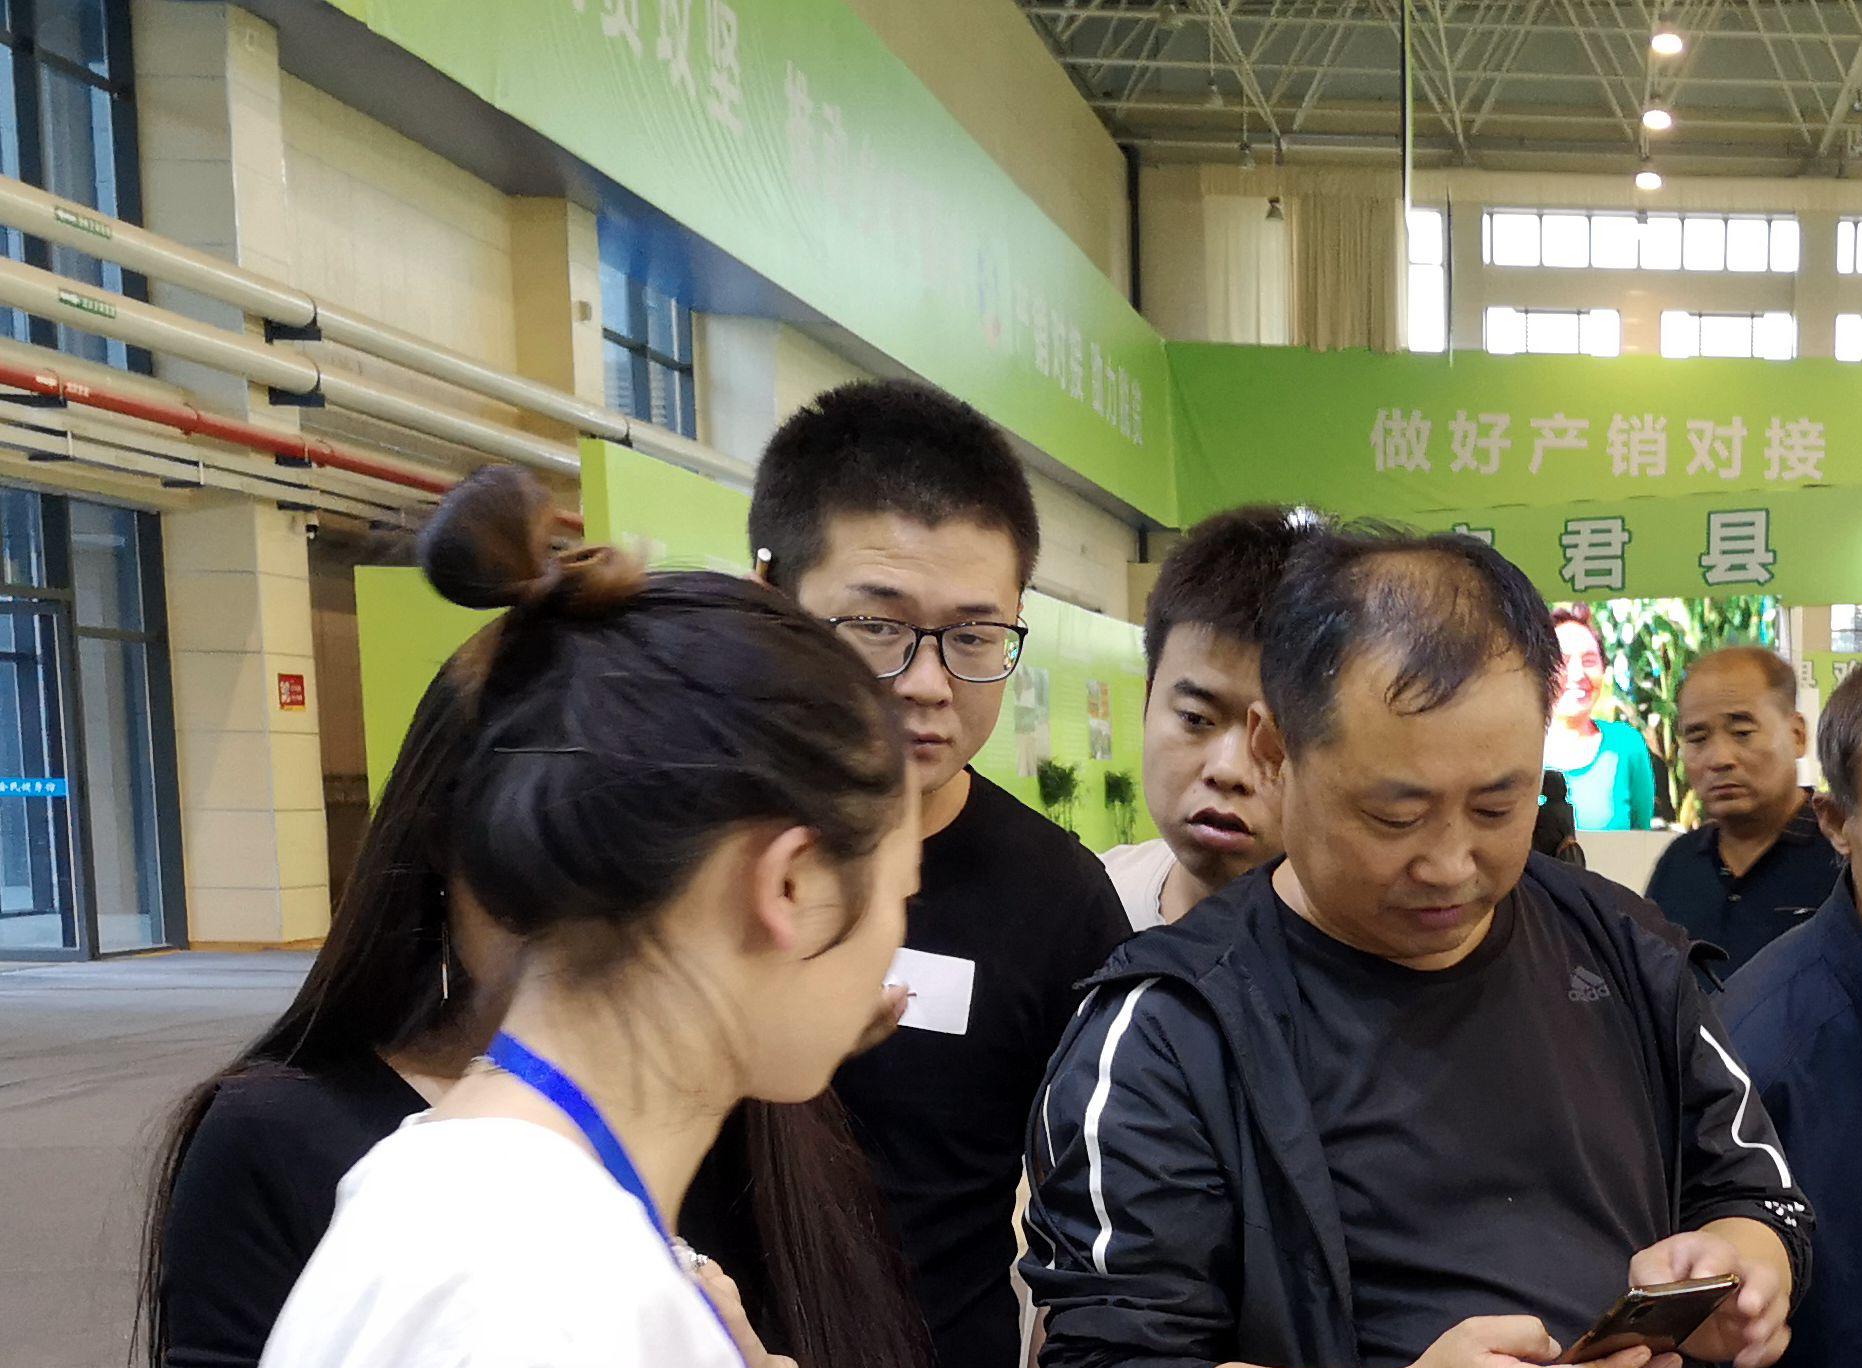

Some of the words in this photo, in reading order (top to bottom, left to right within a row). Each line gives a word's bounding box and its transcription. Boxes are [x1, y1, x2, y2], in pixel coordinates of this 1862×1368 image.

[1369, 408, 1826, 480] 做好产销对接
[1453, 507, 1777, 592] 君县
